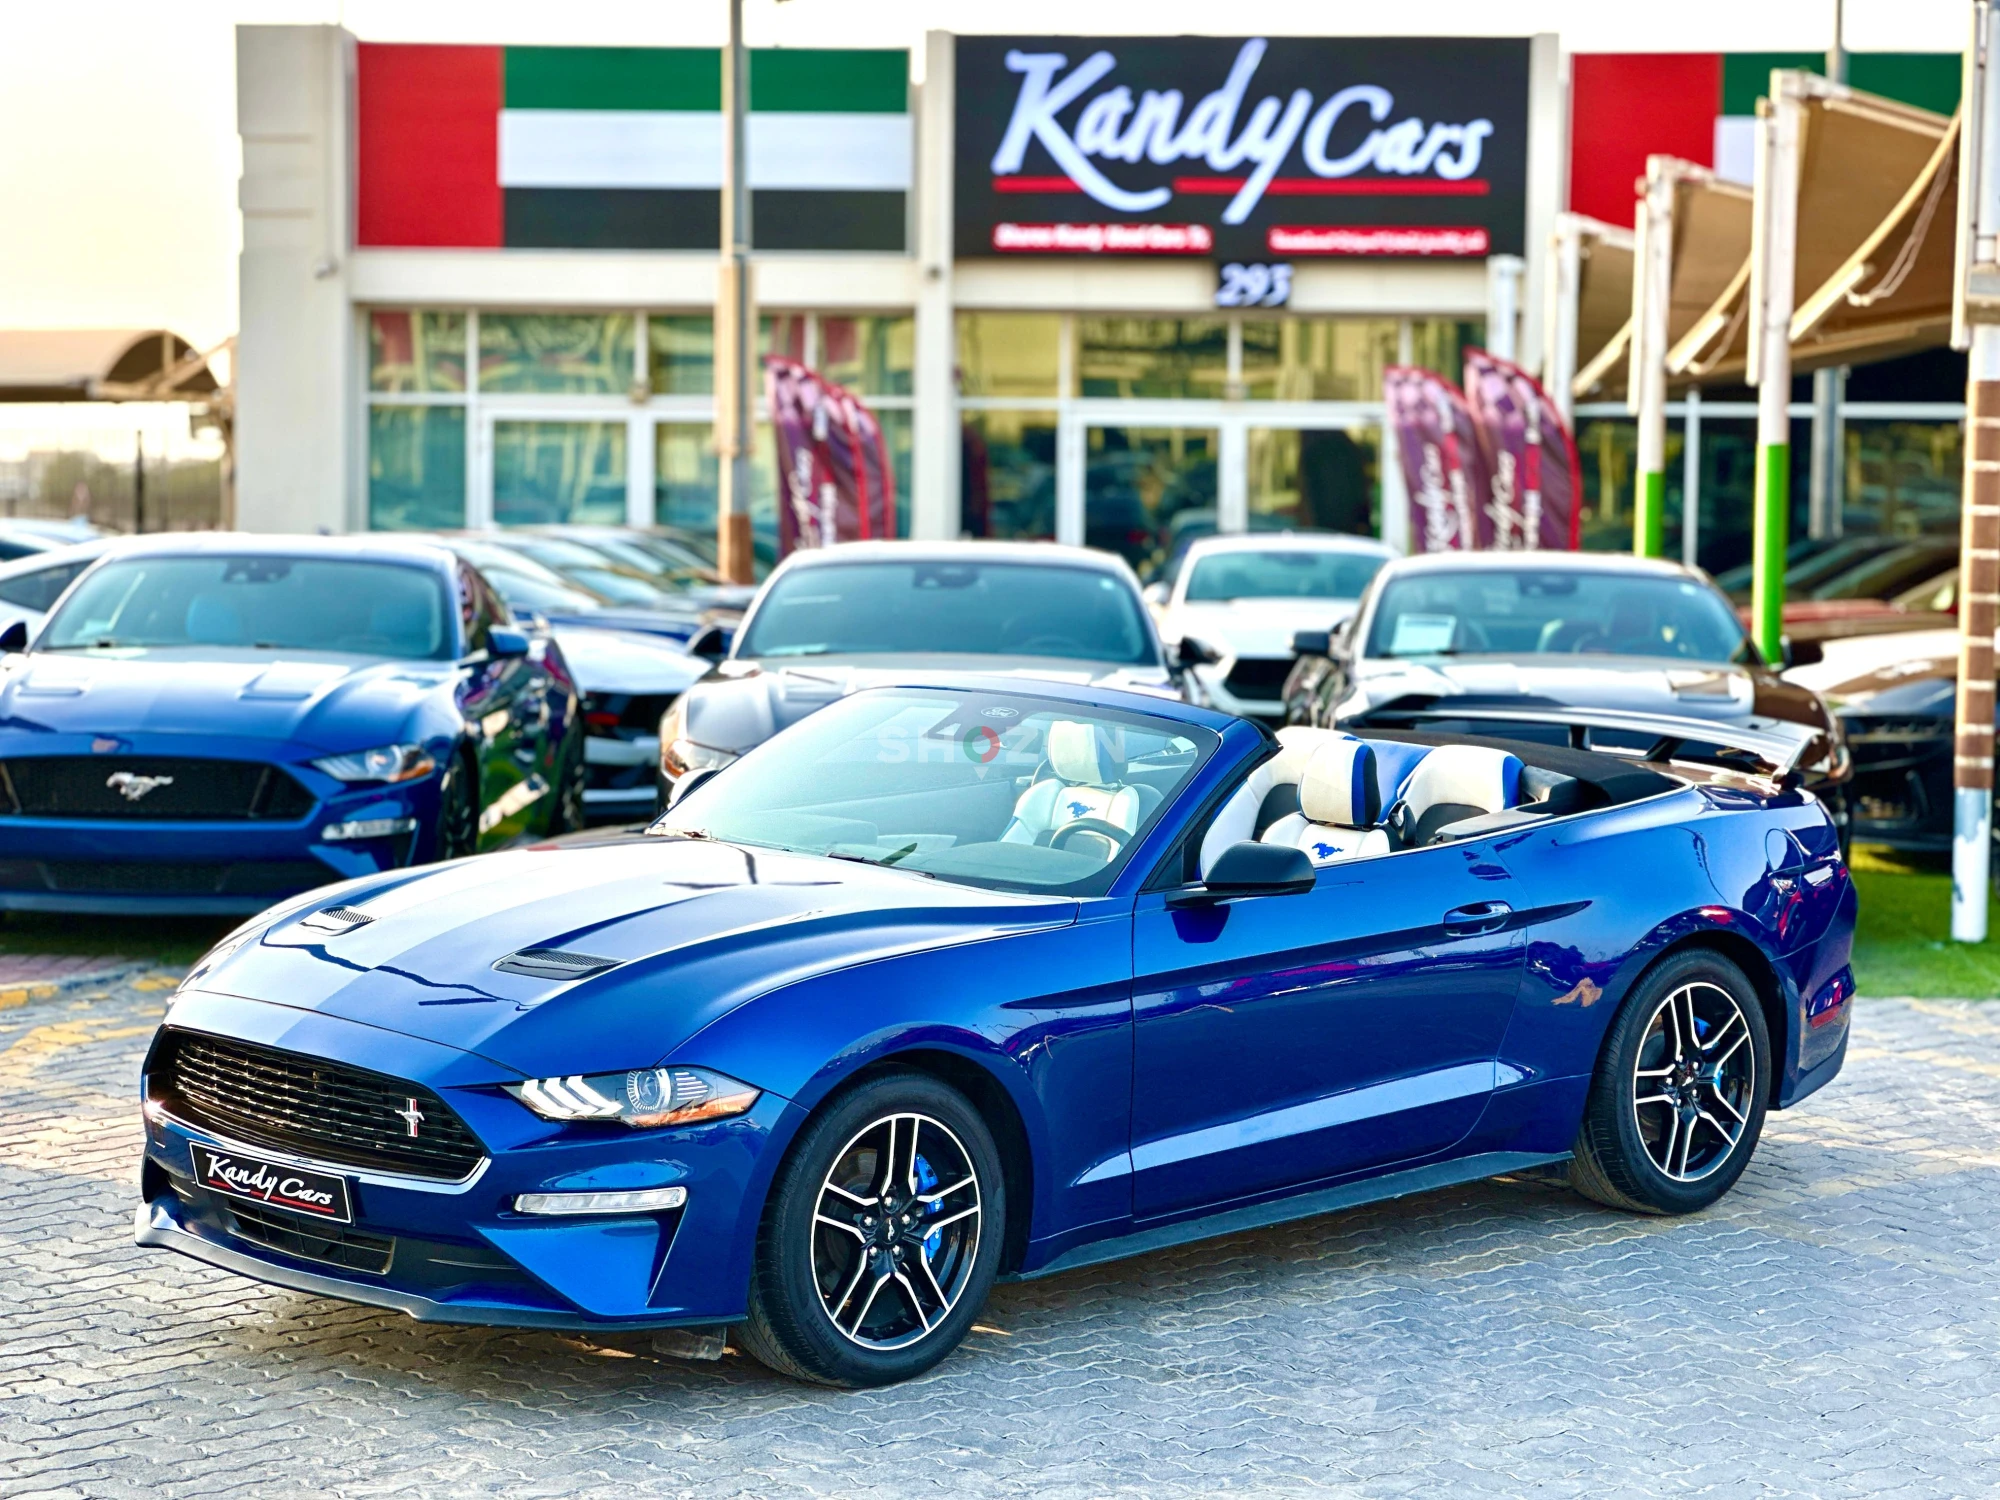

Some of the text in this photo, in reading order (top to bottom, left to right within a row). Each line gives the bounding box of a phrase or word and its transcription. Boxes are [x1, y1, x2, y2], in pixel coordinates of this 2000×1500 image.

[991, 37, 1494, 224] Kandy Cars
[206, 1153, 333, 1205] Kandy Cars
